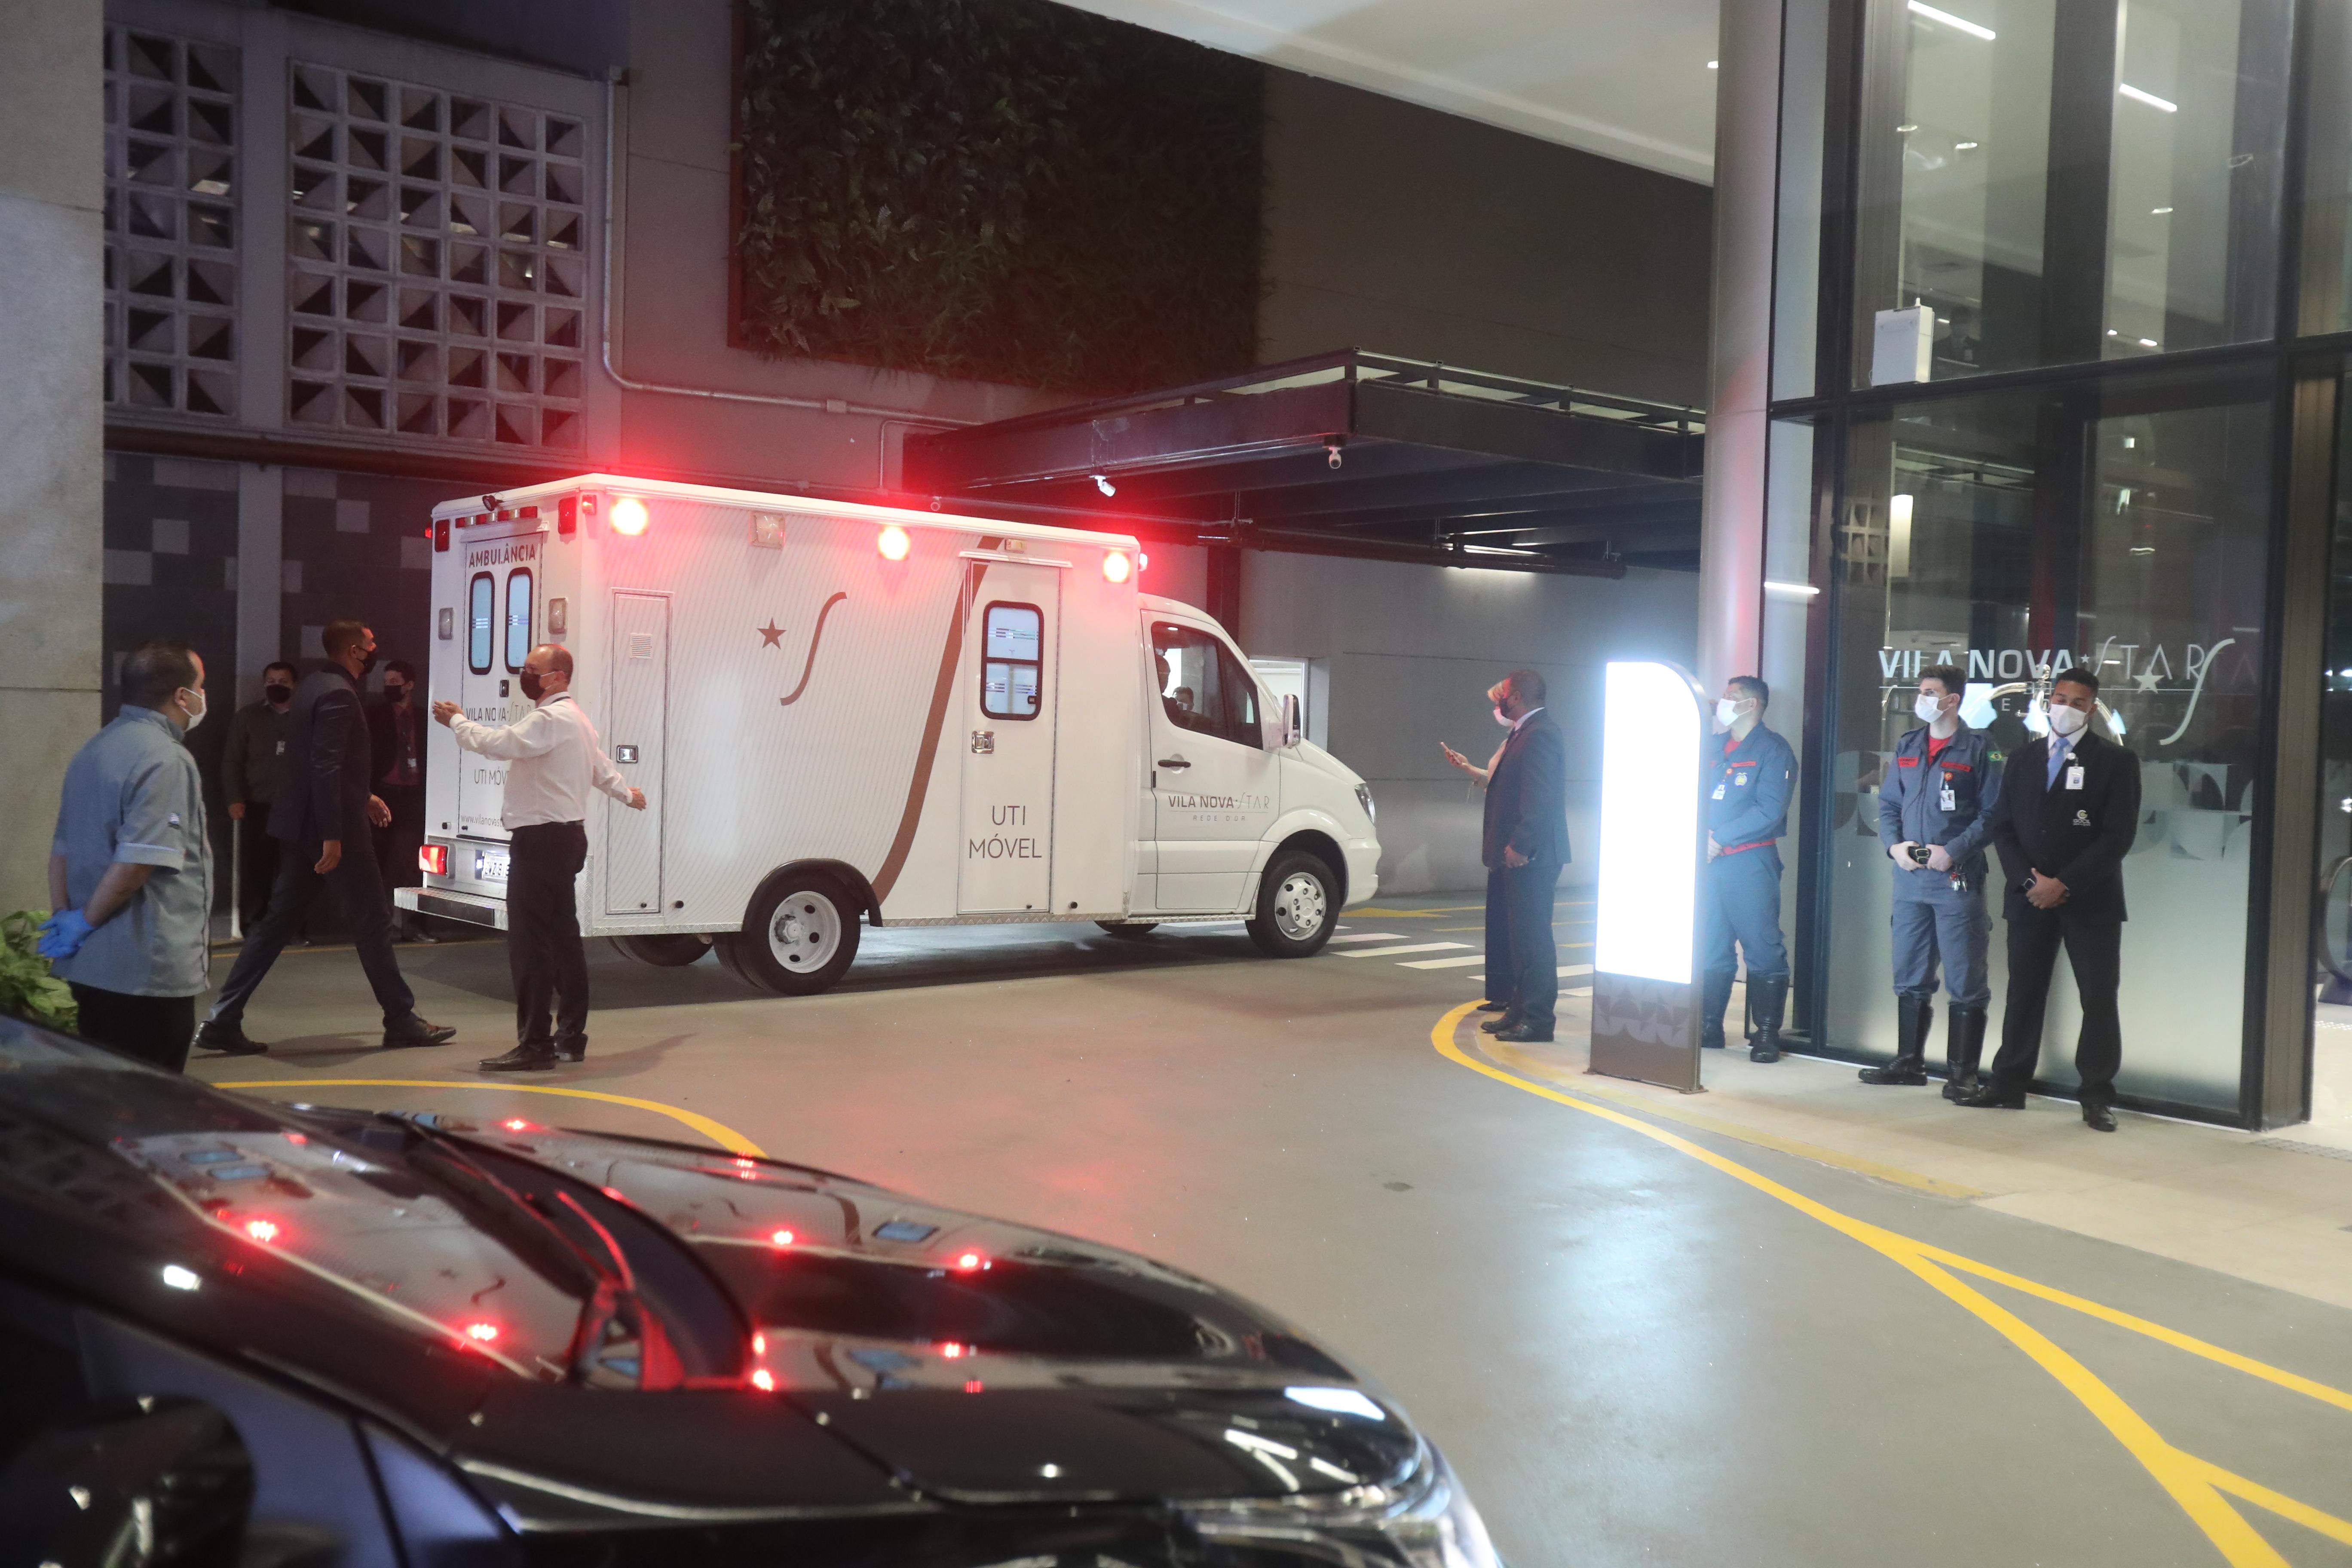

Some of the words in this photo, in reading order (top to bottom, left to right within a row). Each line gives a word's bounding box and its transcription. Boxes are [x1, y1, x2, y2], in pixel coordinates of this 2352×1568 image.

[469, 543, 536, 568] AMBULÂNCIA
[1969, 649, 2074, 679] NOVA
[466, 708, 482, 721] VILA
[474, 769, 487, 784] UTI
[489, 766, 509, 785] MÓV
[1168, 795, 1196, 808] VILA
[1200, 796, 1234, 808] NOVA
[461, 814, 504, 828] www.vilanovast
[992, 805, 1026, 826] UTI
[969, 833, 1042, 859] MÓVEL
